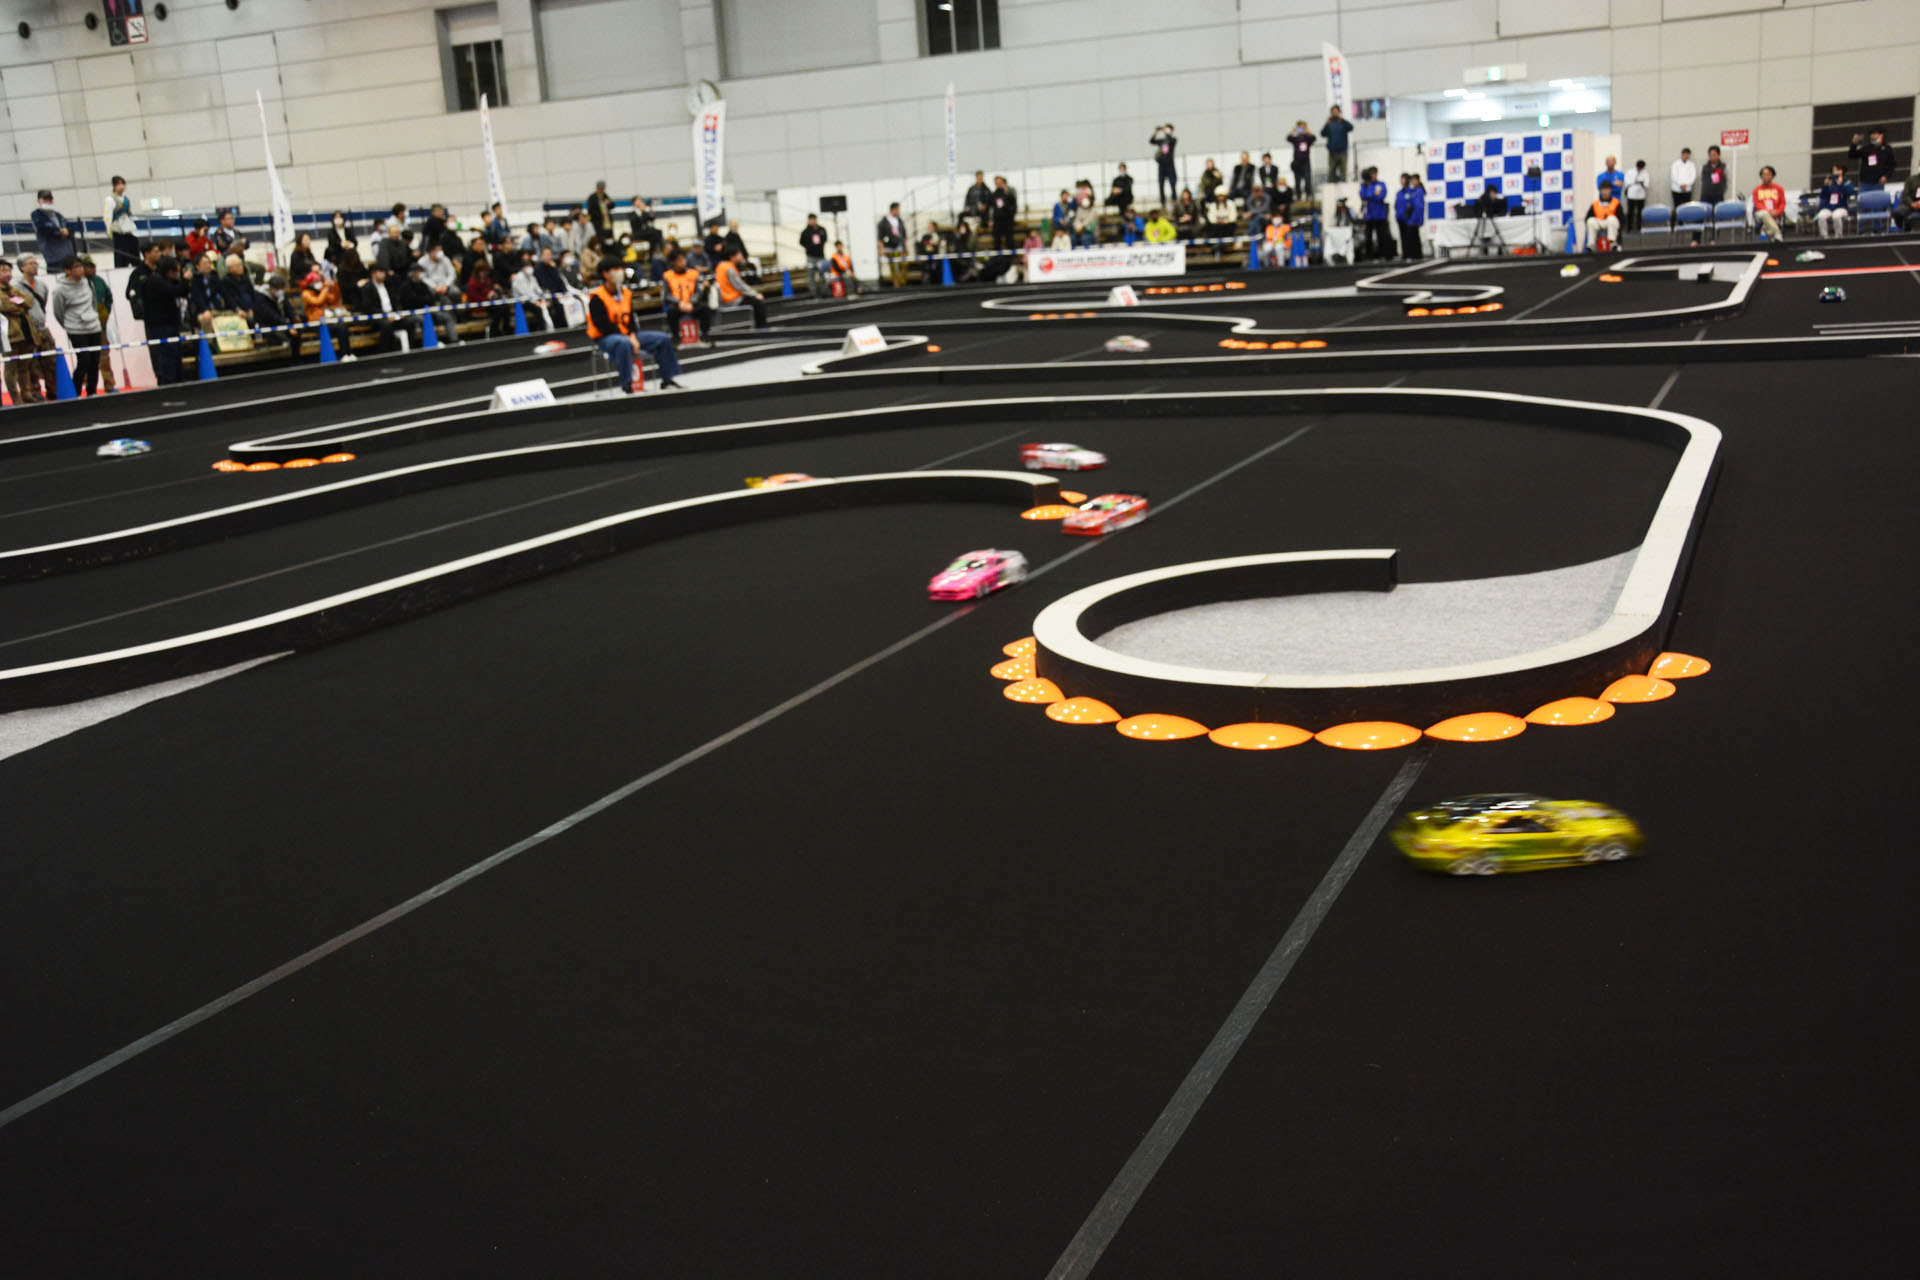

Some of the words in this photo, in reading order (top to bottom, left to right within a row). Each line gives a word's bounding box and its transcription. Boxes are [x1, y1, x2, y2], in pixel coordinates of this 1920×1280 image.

[703, 147, 716, 211] TAMIYA
[1126, 252, 1175, 267] 2025
[682, 323, 697, 338] 11
